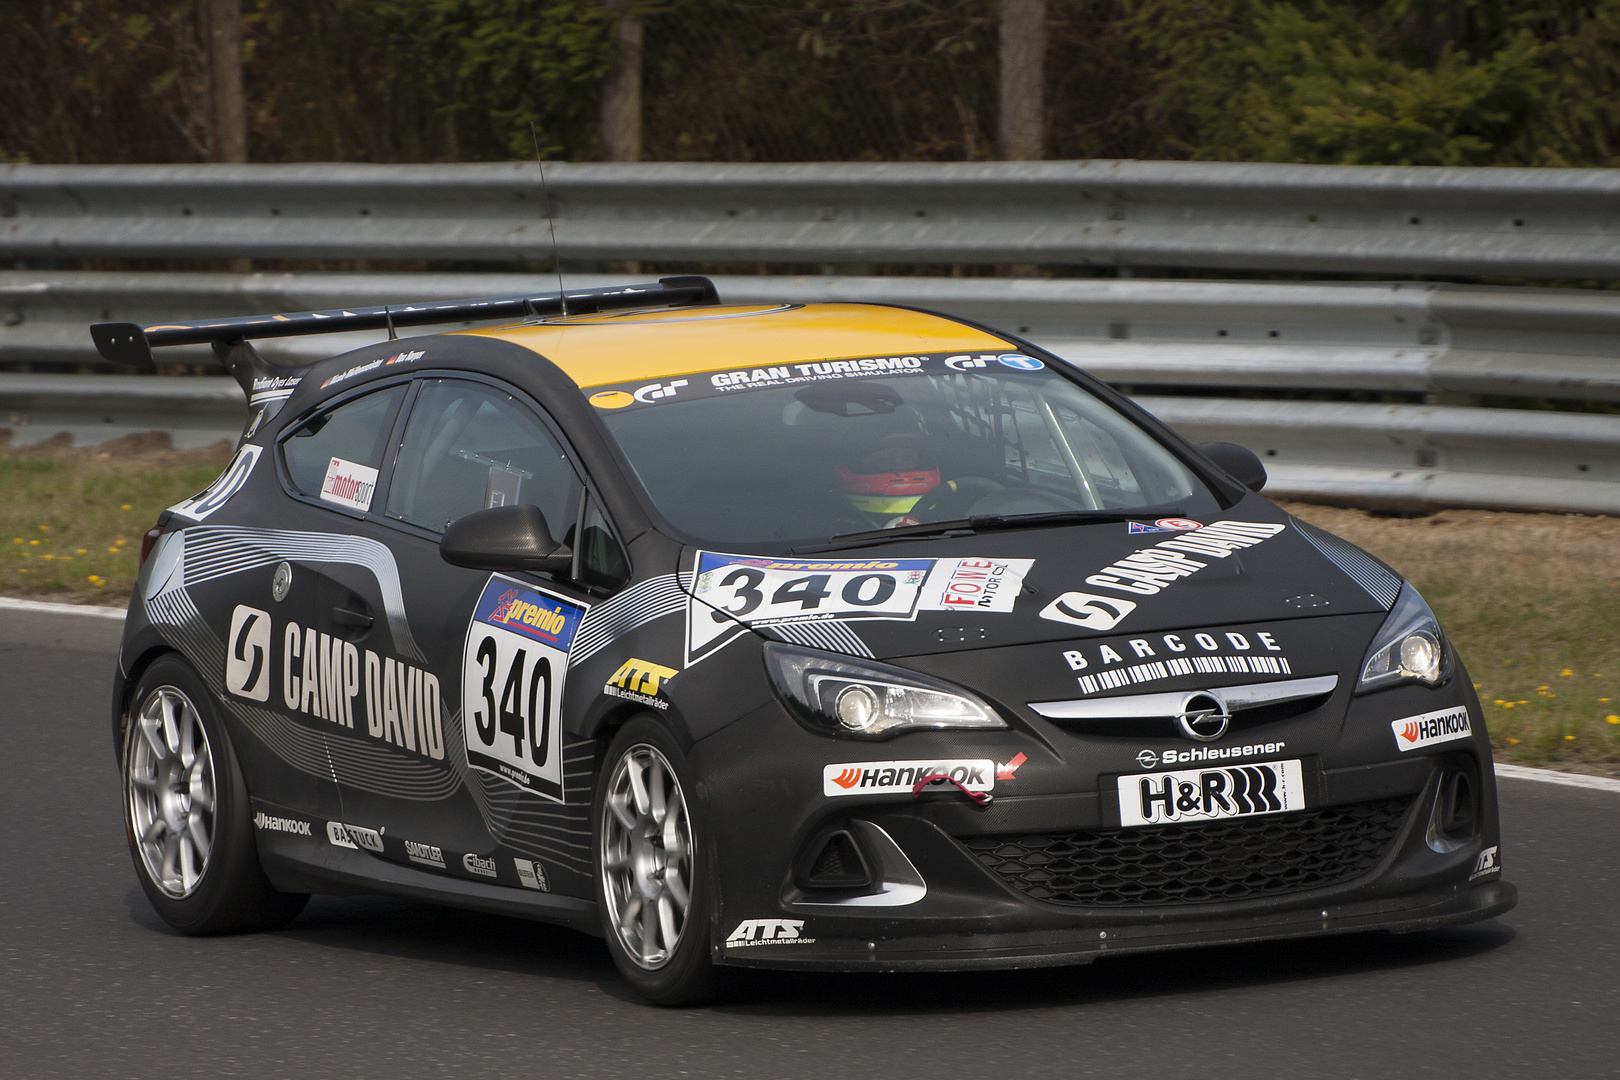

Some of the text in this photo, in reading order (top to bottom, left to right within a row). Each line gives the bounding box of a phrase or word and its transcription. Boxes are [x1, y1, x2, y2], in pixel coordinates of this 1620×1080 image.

[710, 366, 795, 388] GRAN
[716, 367, 925, 392] THE REAL DRIVING SIMULATOR
[765, 560, 899, 571] premio
[1085, 519, 1286, 596] CAMP DAVID
[709, 567, 897, 624] 340
[503, 597, 566, 636] premio
[751, 612, 835, 624] www.premio.de
[1062, 631, 1282, 671] BARCODE
[606, 657, 680, 696] ATS
[283, 621, 446, 761] CAMP DAVID
[473, 635, 553, 768] 340
[617, 687, 669, 711] Leichtmetallräder
[1161, 741, 1286, 764] Schleusener
[1139, 771, 1234, 821] H&R
[332, 826, 379, 848] BASTUCK
[463, 852, 497, 874] Eibach
[726, 918, 805, 942] ATS
[745, 938, 817, 947] Leichtmetallräder
